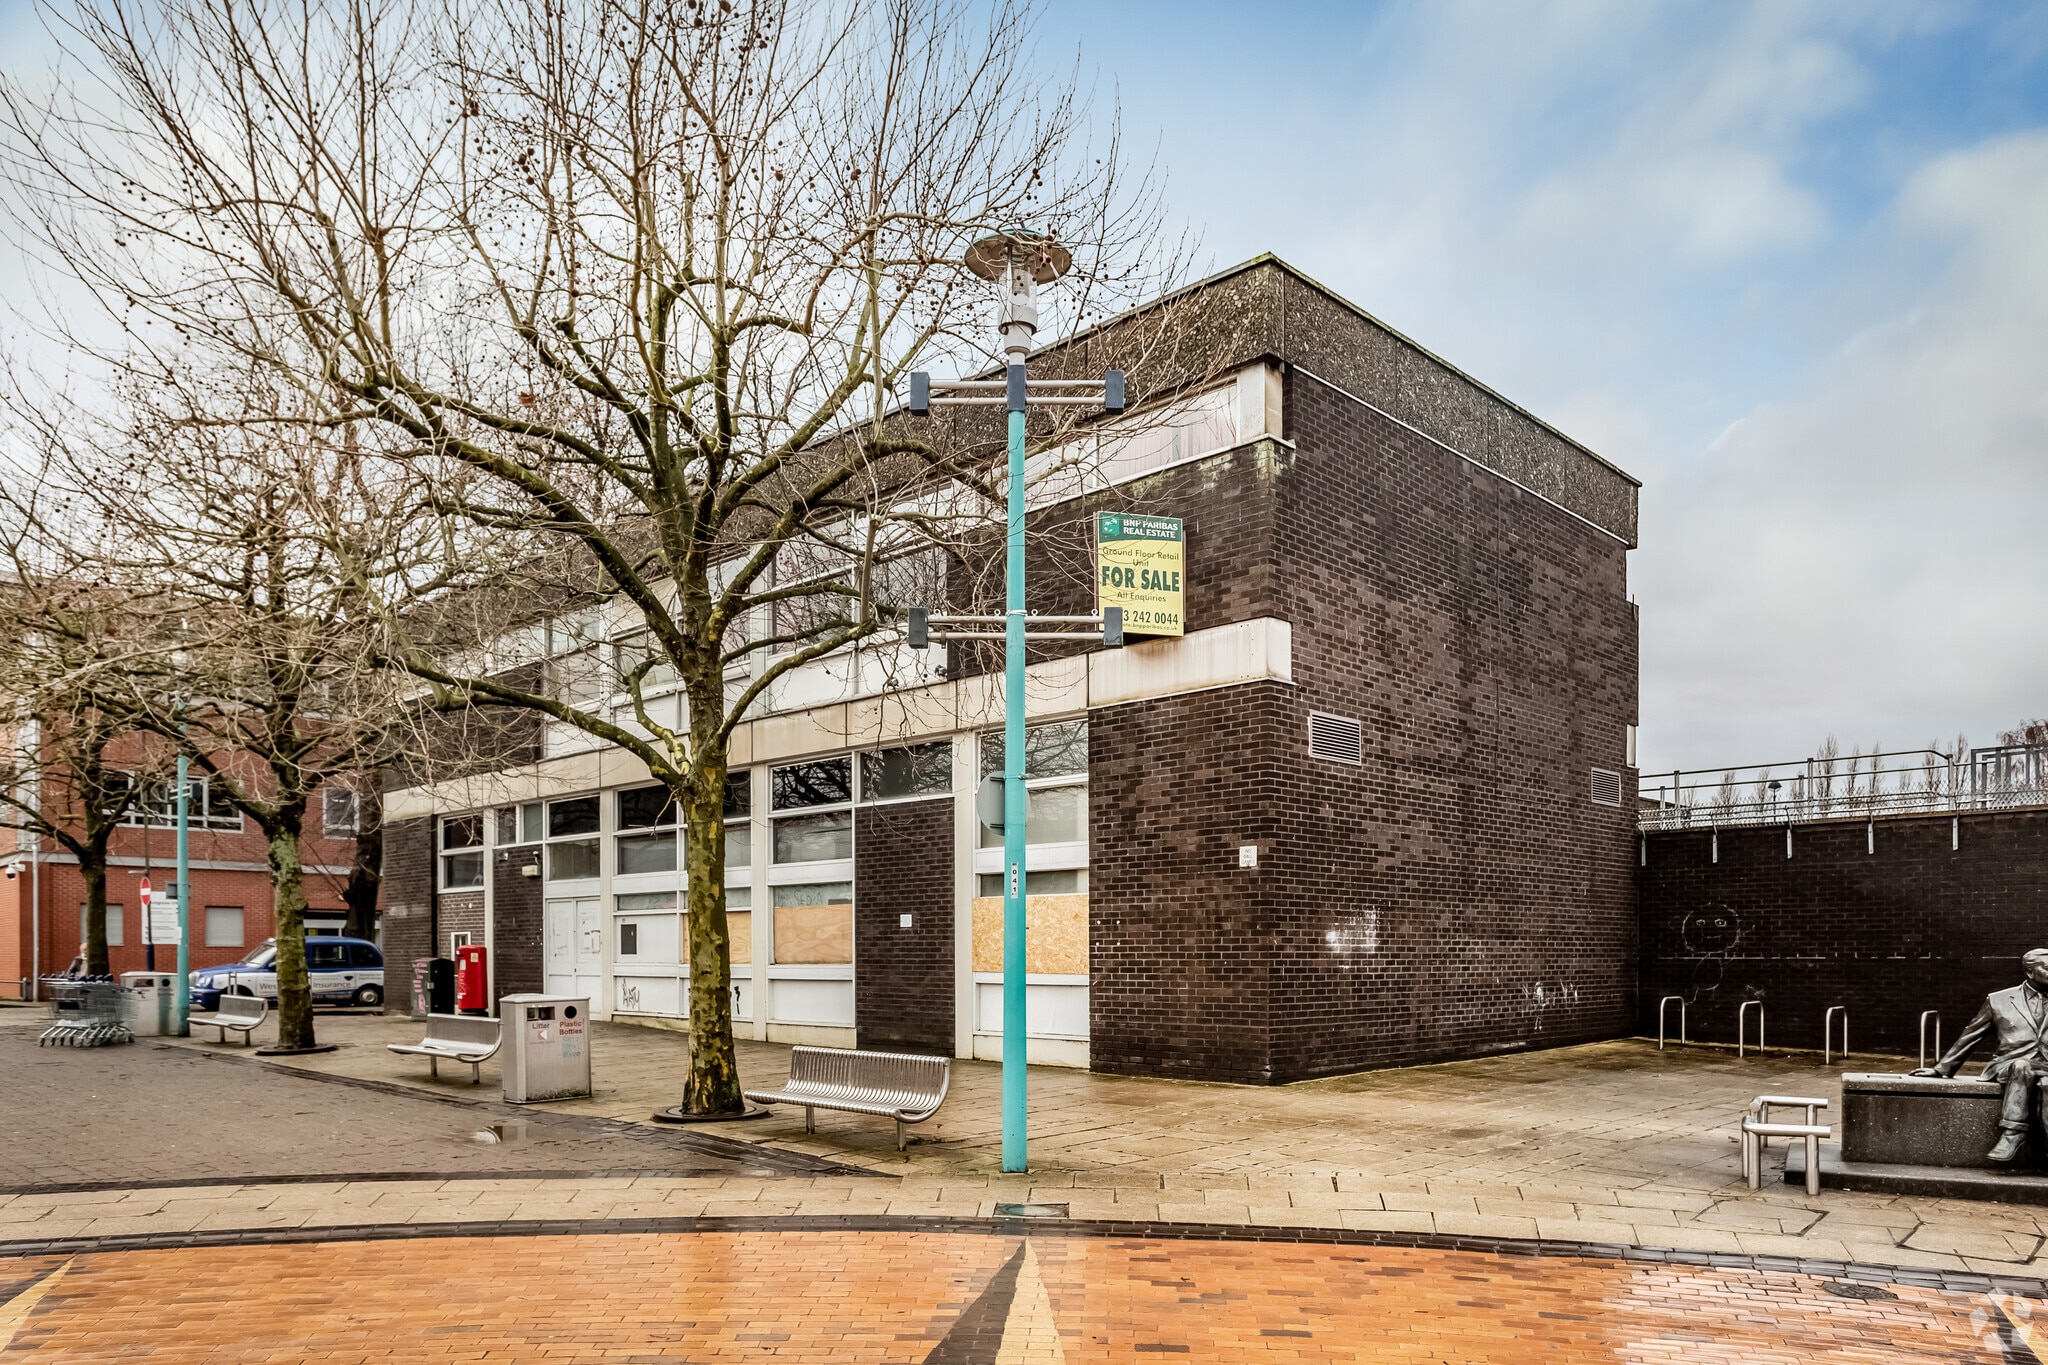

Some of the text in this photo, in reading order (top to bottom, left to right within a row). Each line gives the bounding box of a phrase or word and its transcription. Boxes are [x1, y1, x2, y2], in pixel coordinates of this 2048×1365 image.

[1123, 519, 1178, 531] BNP PARIBAS
[1123, 527, 1176, 539] REAL ESTATE
[1102, 546, 1179, 560] Ground Floor Retail
[1102, 566, 1180, 592] FOR SALE
[1116, 591, 1166, 603] All Enquiries
[1133, 610, 1151, 623] 242
[1154, 612, 1178, 625] 0044
[313, 981, 352, 990] Insurance
